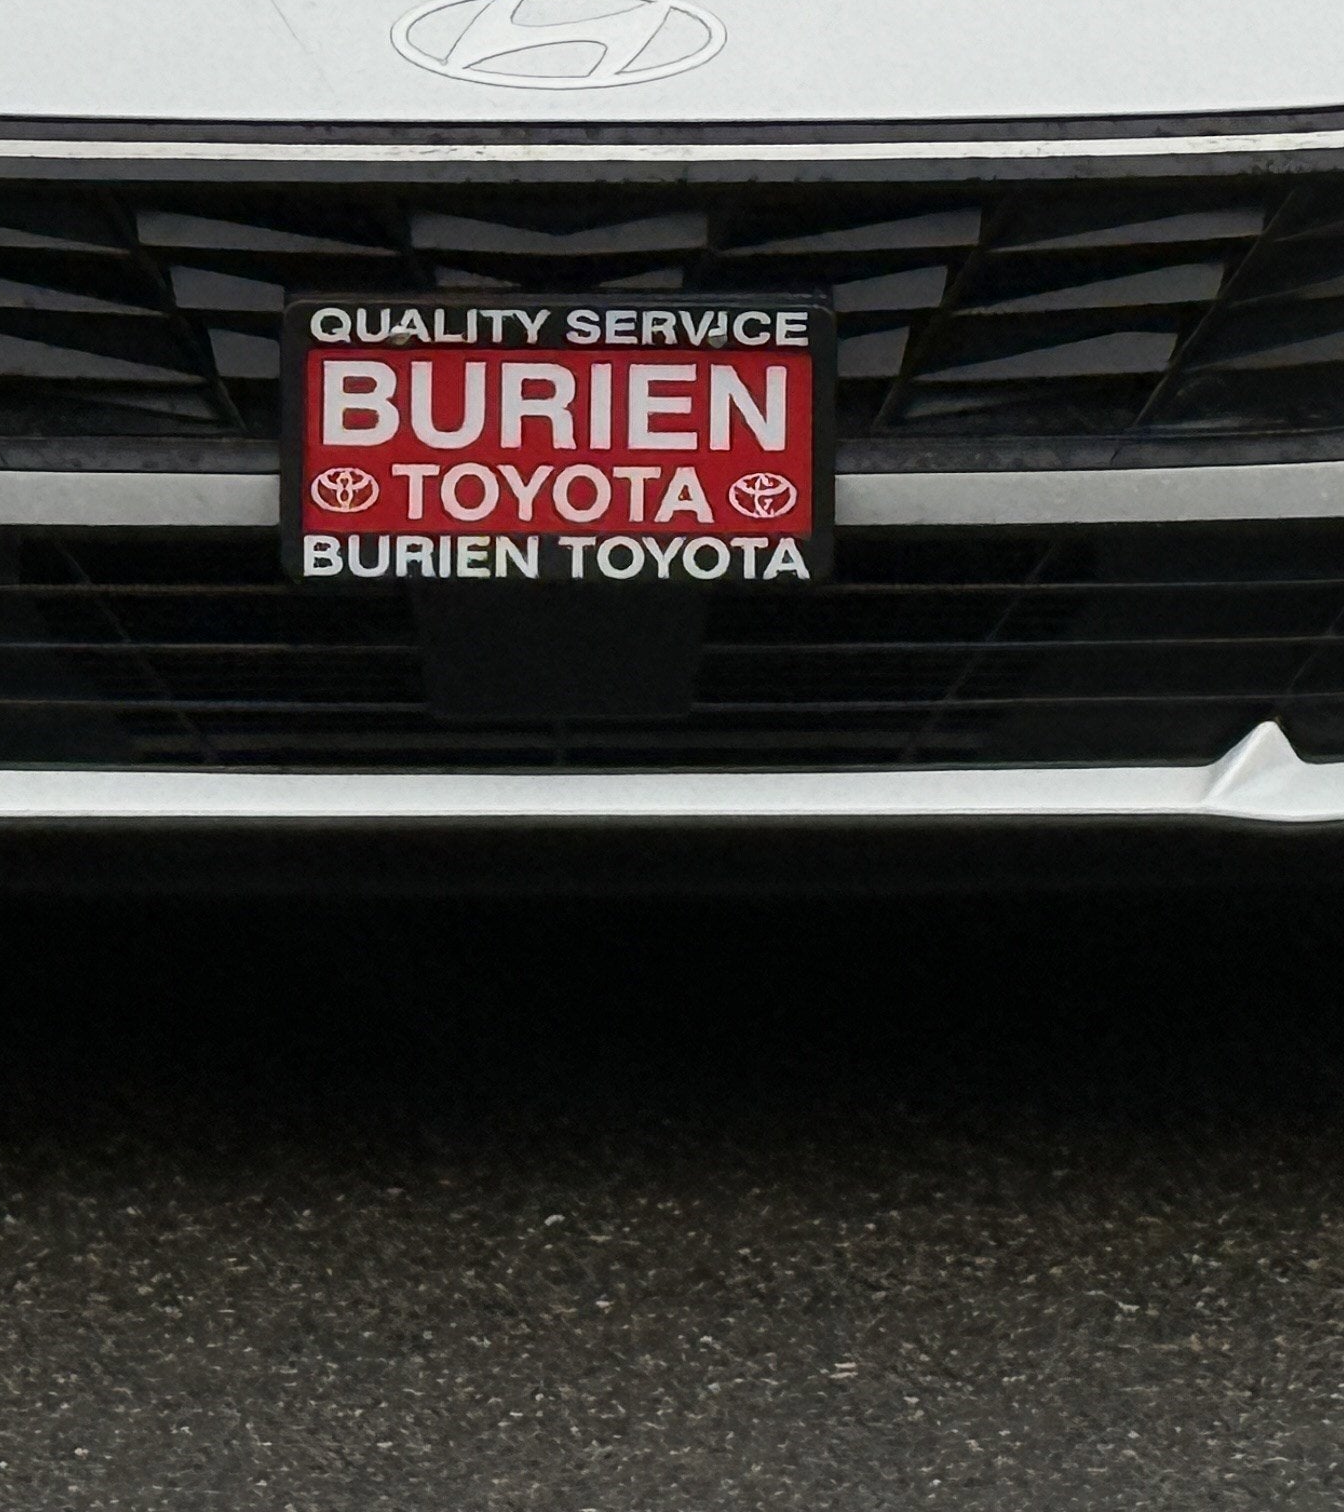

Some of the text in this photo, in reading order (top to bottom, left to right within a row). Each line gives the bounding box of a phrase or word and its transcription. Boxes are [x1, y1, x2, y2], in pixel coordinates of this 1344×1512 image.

[310, 307, 809, 346] QUALITY SERVICE
[322, 360, 787, 451] BURIEN
[391, 462, 714, 524] TOYOTA
[303, 534, 811, 580] BURIEN TOYOTA
